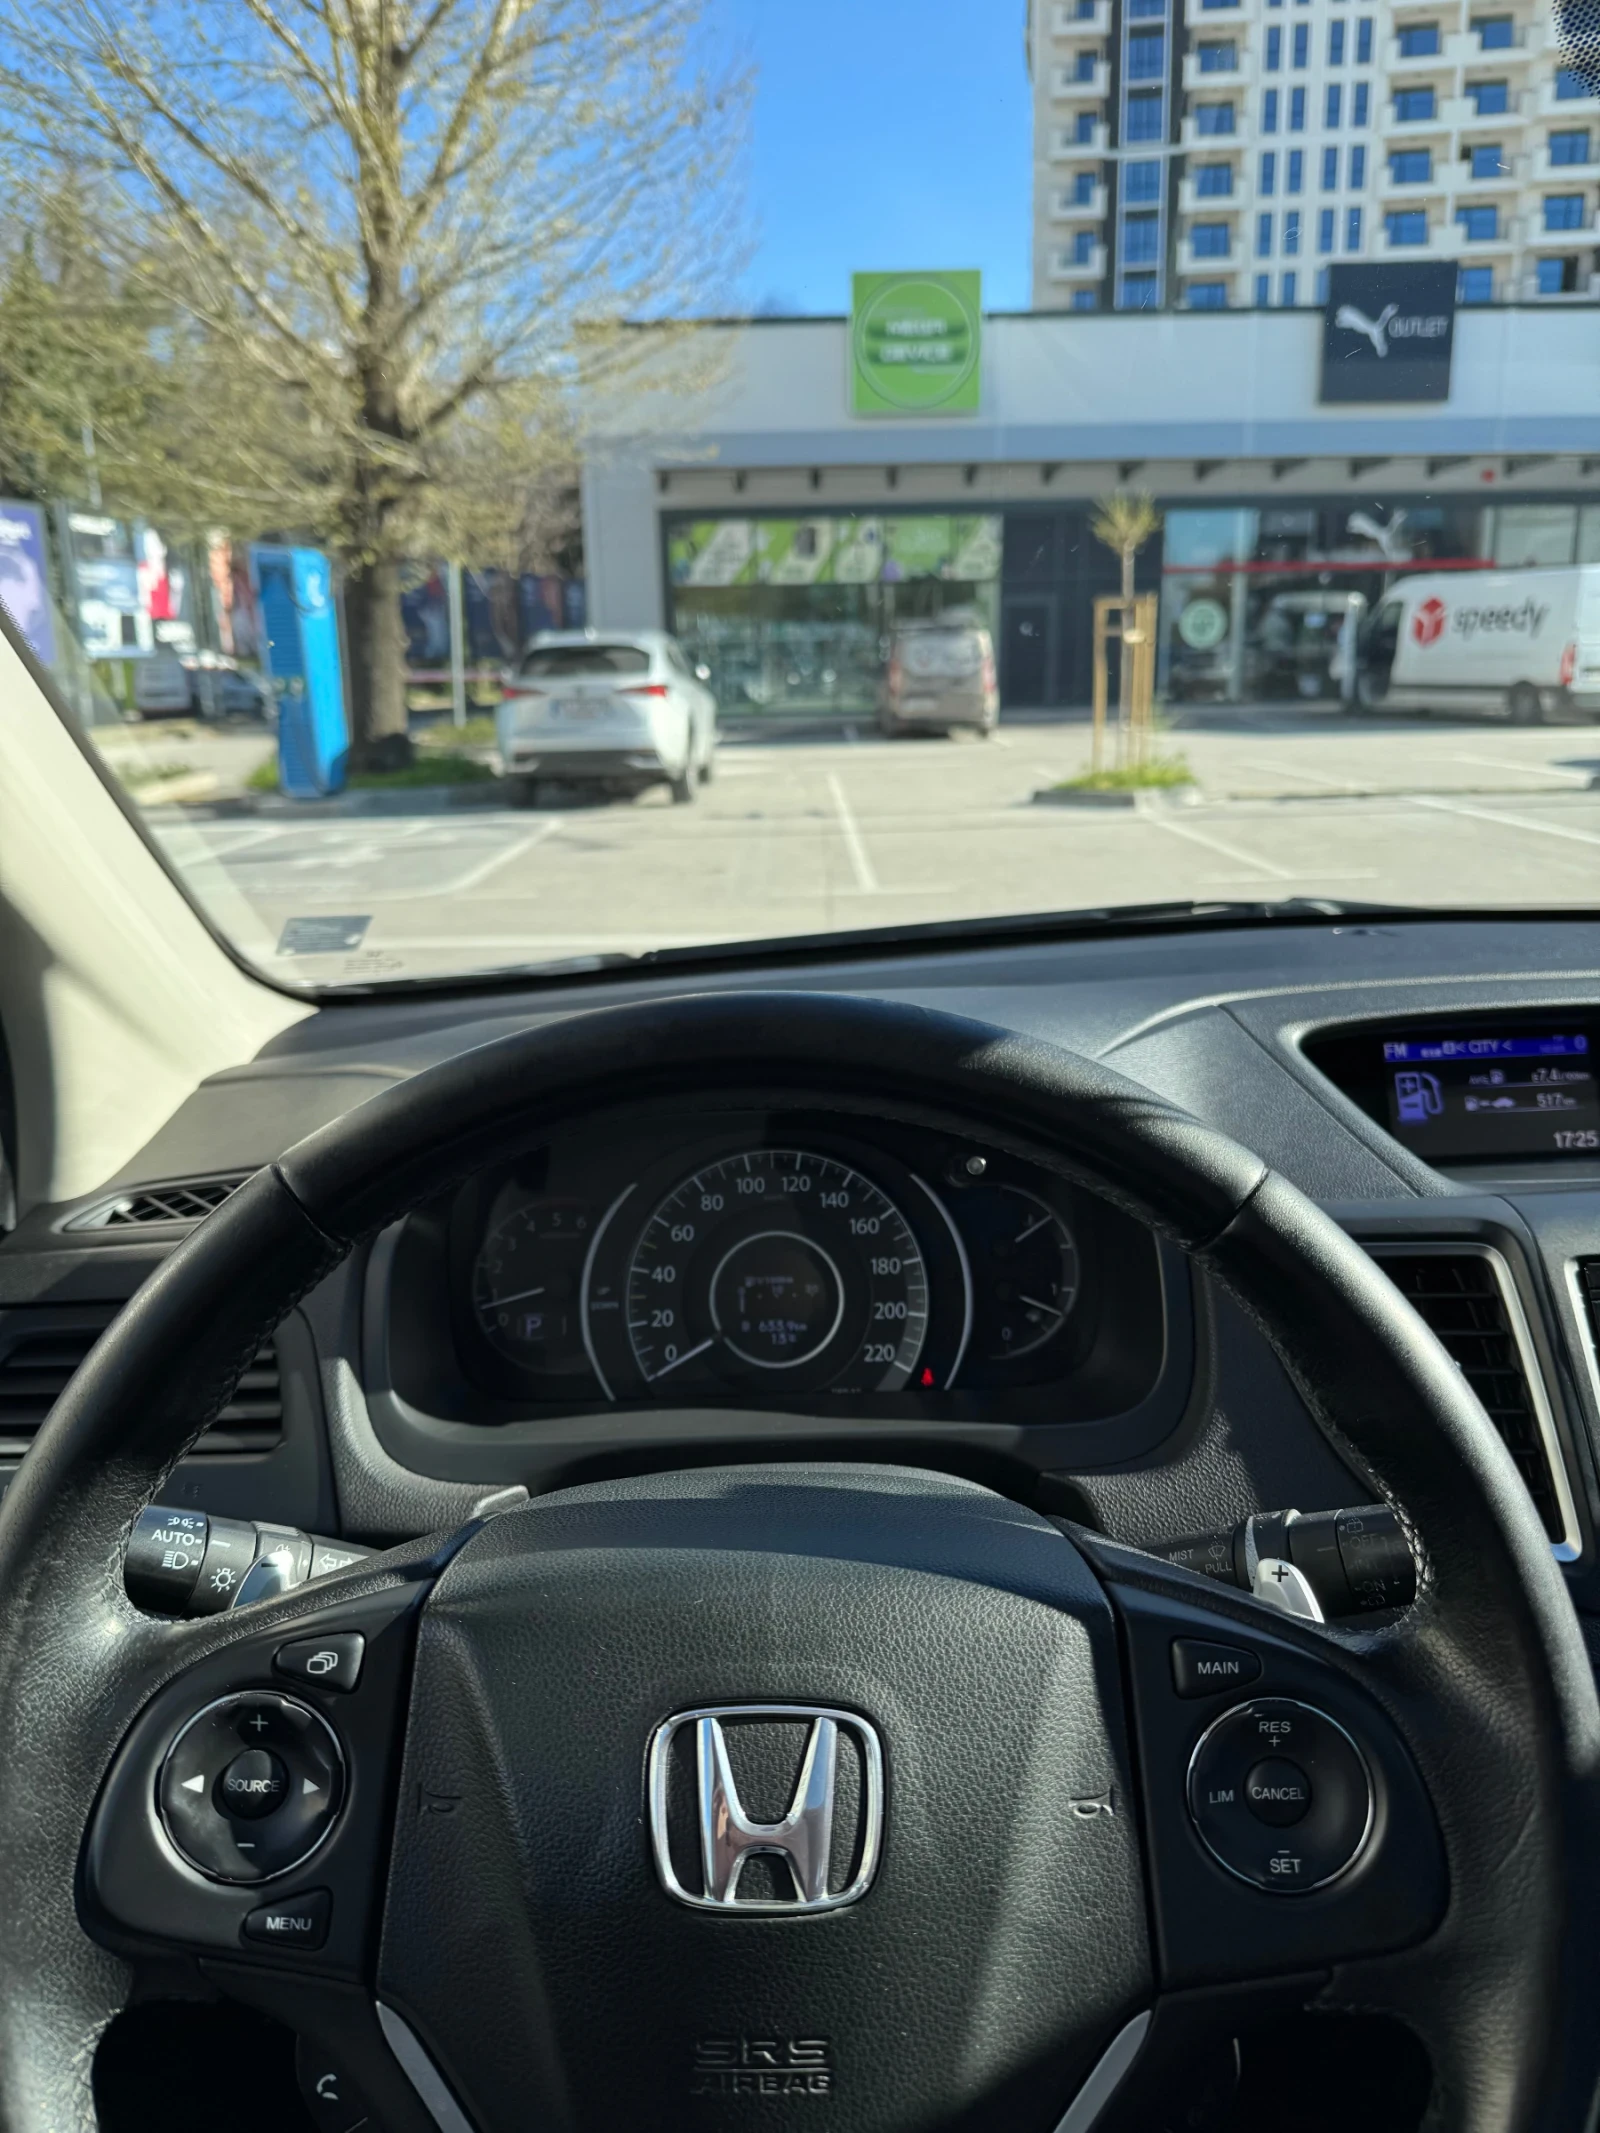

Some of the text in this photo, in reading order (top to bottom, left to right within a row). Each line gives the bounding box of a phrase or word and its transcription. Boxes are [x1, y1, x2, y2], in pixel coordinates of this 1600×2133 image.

[1452, 595, 1550, 641] speedy
[1383, 1042, 1408, 1059] FM
[1468, 1038, 1500, 1054] CITY
[1536, 1091, 1563, 1108] 517
[736, 1177, 766, 1195] 100
[781, 1175, 811, 1192] 120
[700, 1195, 724, 1211] 80
[820, 1191, 850, 1208] 140
[670, 1225, 695, 1242] 60
[849, 1217, 880, 1235] 160
[651, 1266, 676, 1283] 40
[870, 1257, 901, 1275] 180
[651, 1310, 674, 1327] 20
[874, 1302, 906, 1319] 200
[525, 1316, 543, 1337] P
[664, 1345, 678, 1362] 0
[864, 1345, 896, 1362] 220
[151, 1529, 195, 1546] AUTO
[1168, 1548, 1194, 1562] MIST
[1204, 1562, 1232, 1574] PULL
[1363, 1579, 1387, 1594] ON
[1197, 1661, 1239, 1675] MAIN
[1258, 1721, 1291, 1733] RES
[227, 1777, 280, 1793] SOURCE
[1251, 1786, 1304, 1801] CANCEL
[1209, 1790, 1235, 1804] LIM
[1269, 1858, 1301, 1874] SET
[265, 1916, 312, 1931] MENU
[694, 2038, 831, 2066] SRS
[692, 2073, 831, 2096] AIRBAG
